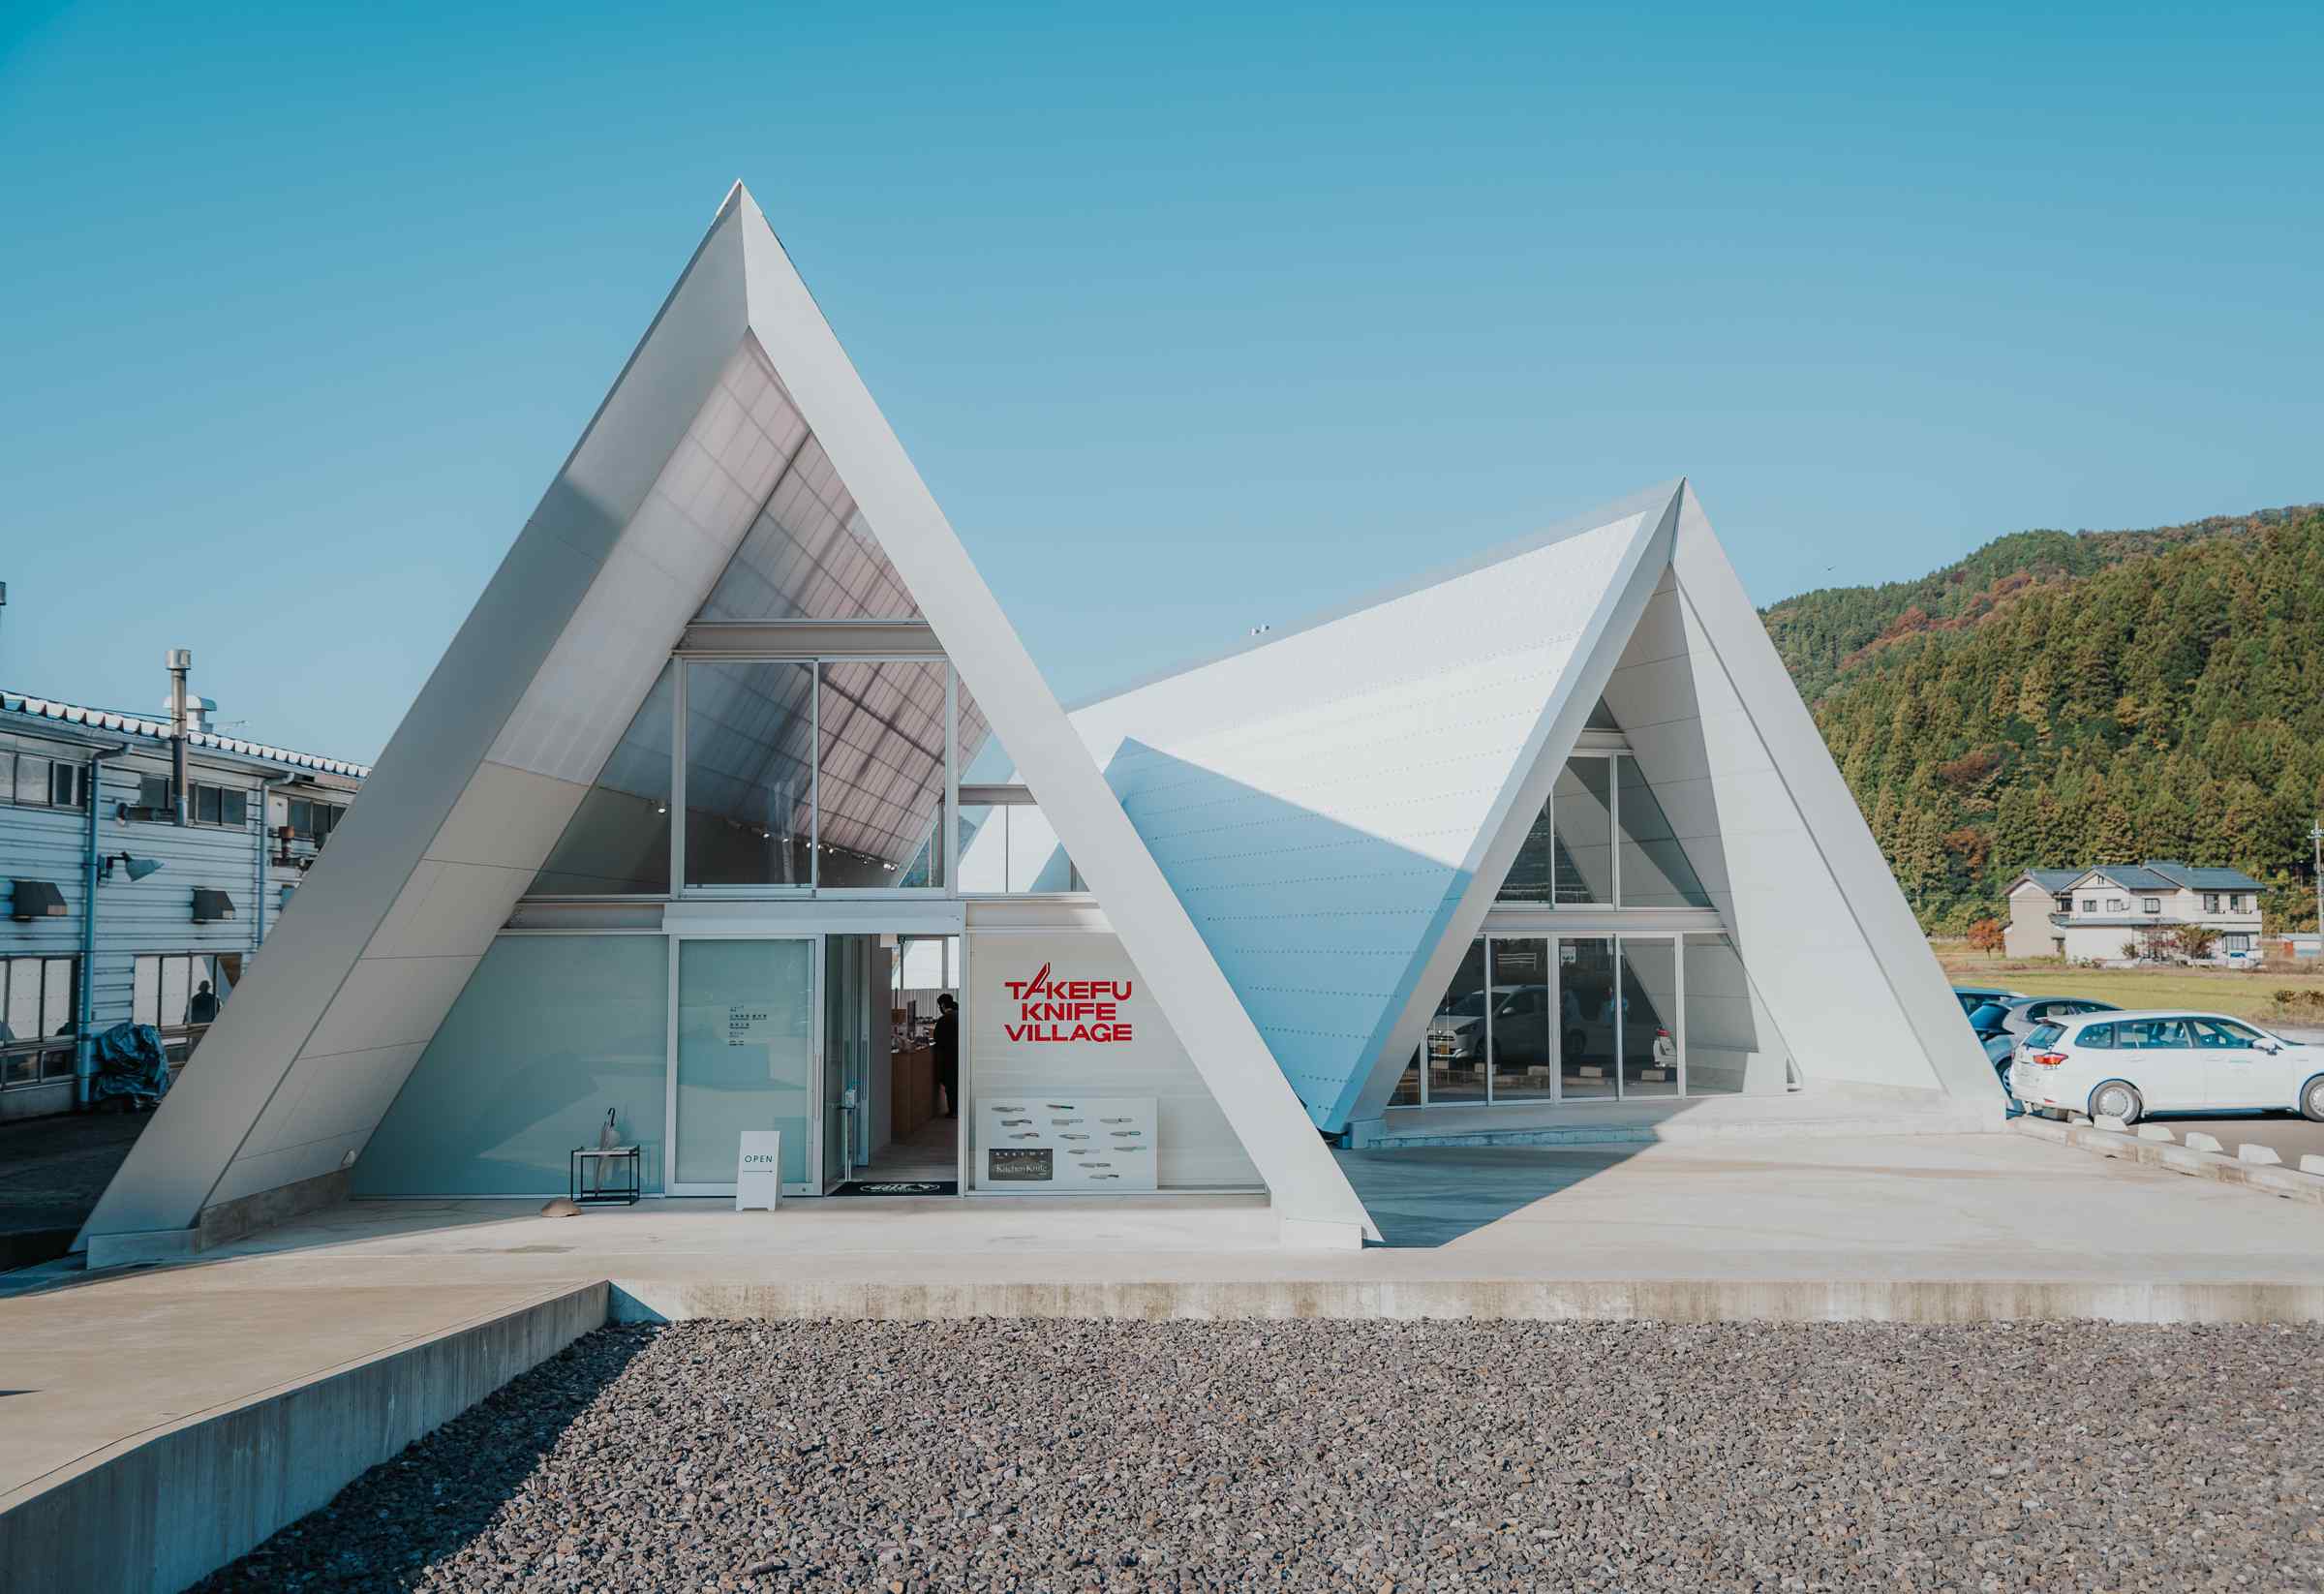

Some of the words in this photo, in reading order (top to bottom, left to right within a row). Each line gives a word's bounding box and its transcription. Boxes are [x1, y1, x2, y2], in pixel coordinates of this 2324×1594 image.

[1005, 962, 1132, 1001] TAKEFU
[1022, 1003, 1116, 1022] KNIFE
[1004, 1024, 1132, 1042] VILLAGE
[744, 1154, 773, 1163] OPEN
